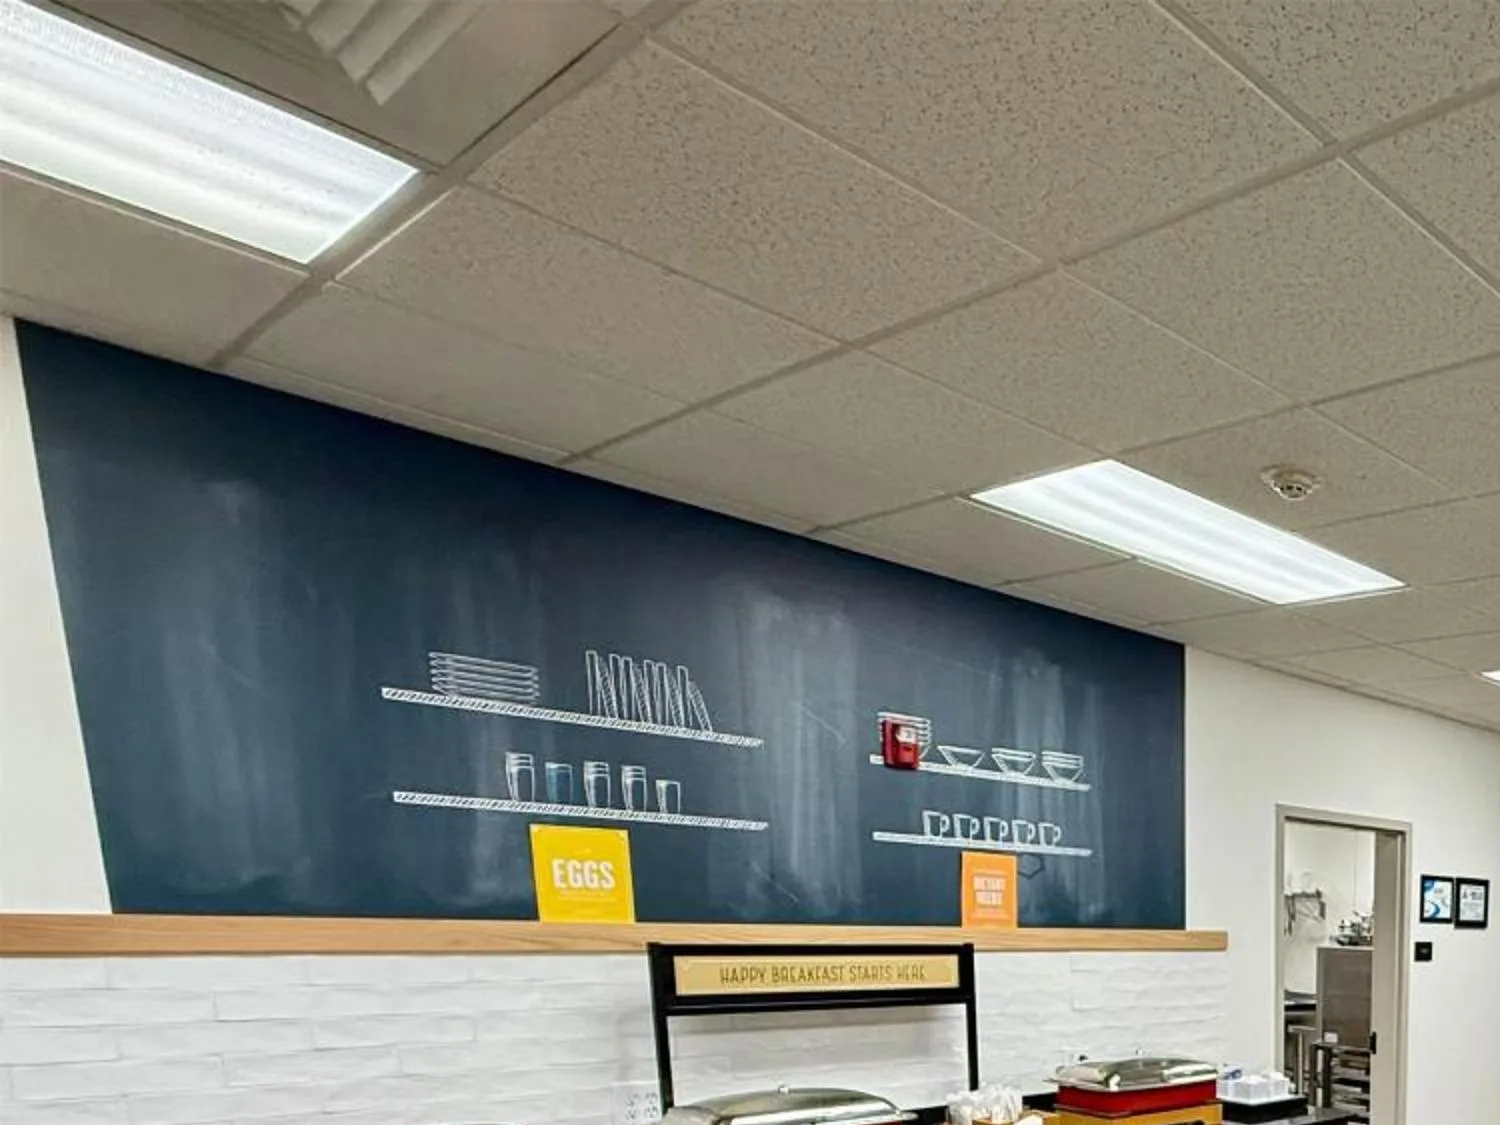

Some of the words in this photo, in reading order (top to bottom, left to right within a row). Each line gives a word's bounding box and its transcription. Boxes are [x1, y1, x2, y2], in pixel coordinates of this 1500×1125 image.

[551, 858, 616, 890] EGGS
[719, 966, 767, 985] HAPPY
[771, 965, 845, 983] BREAKFAST
[849, 964, 893, 982] STARTS
